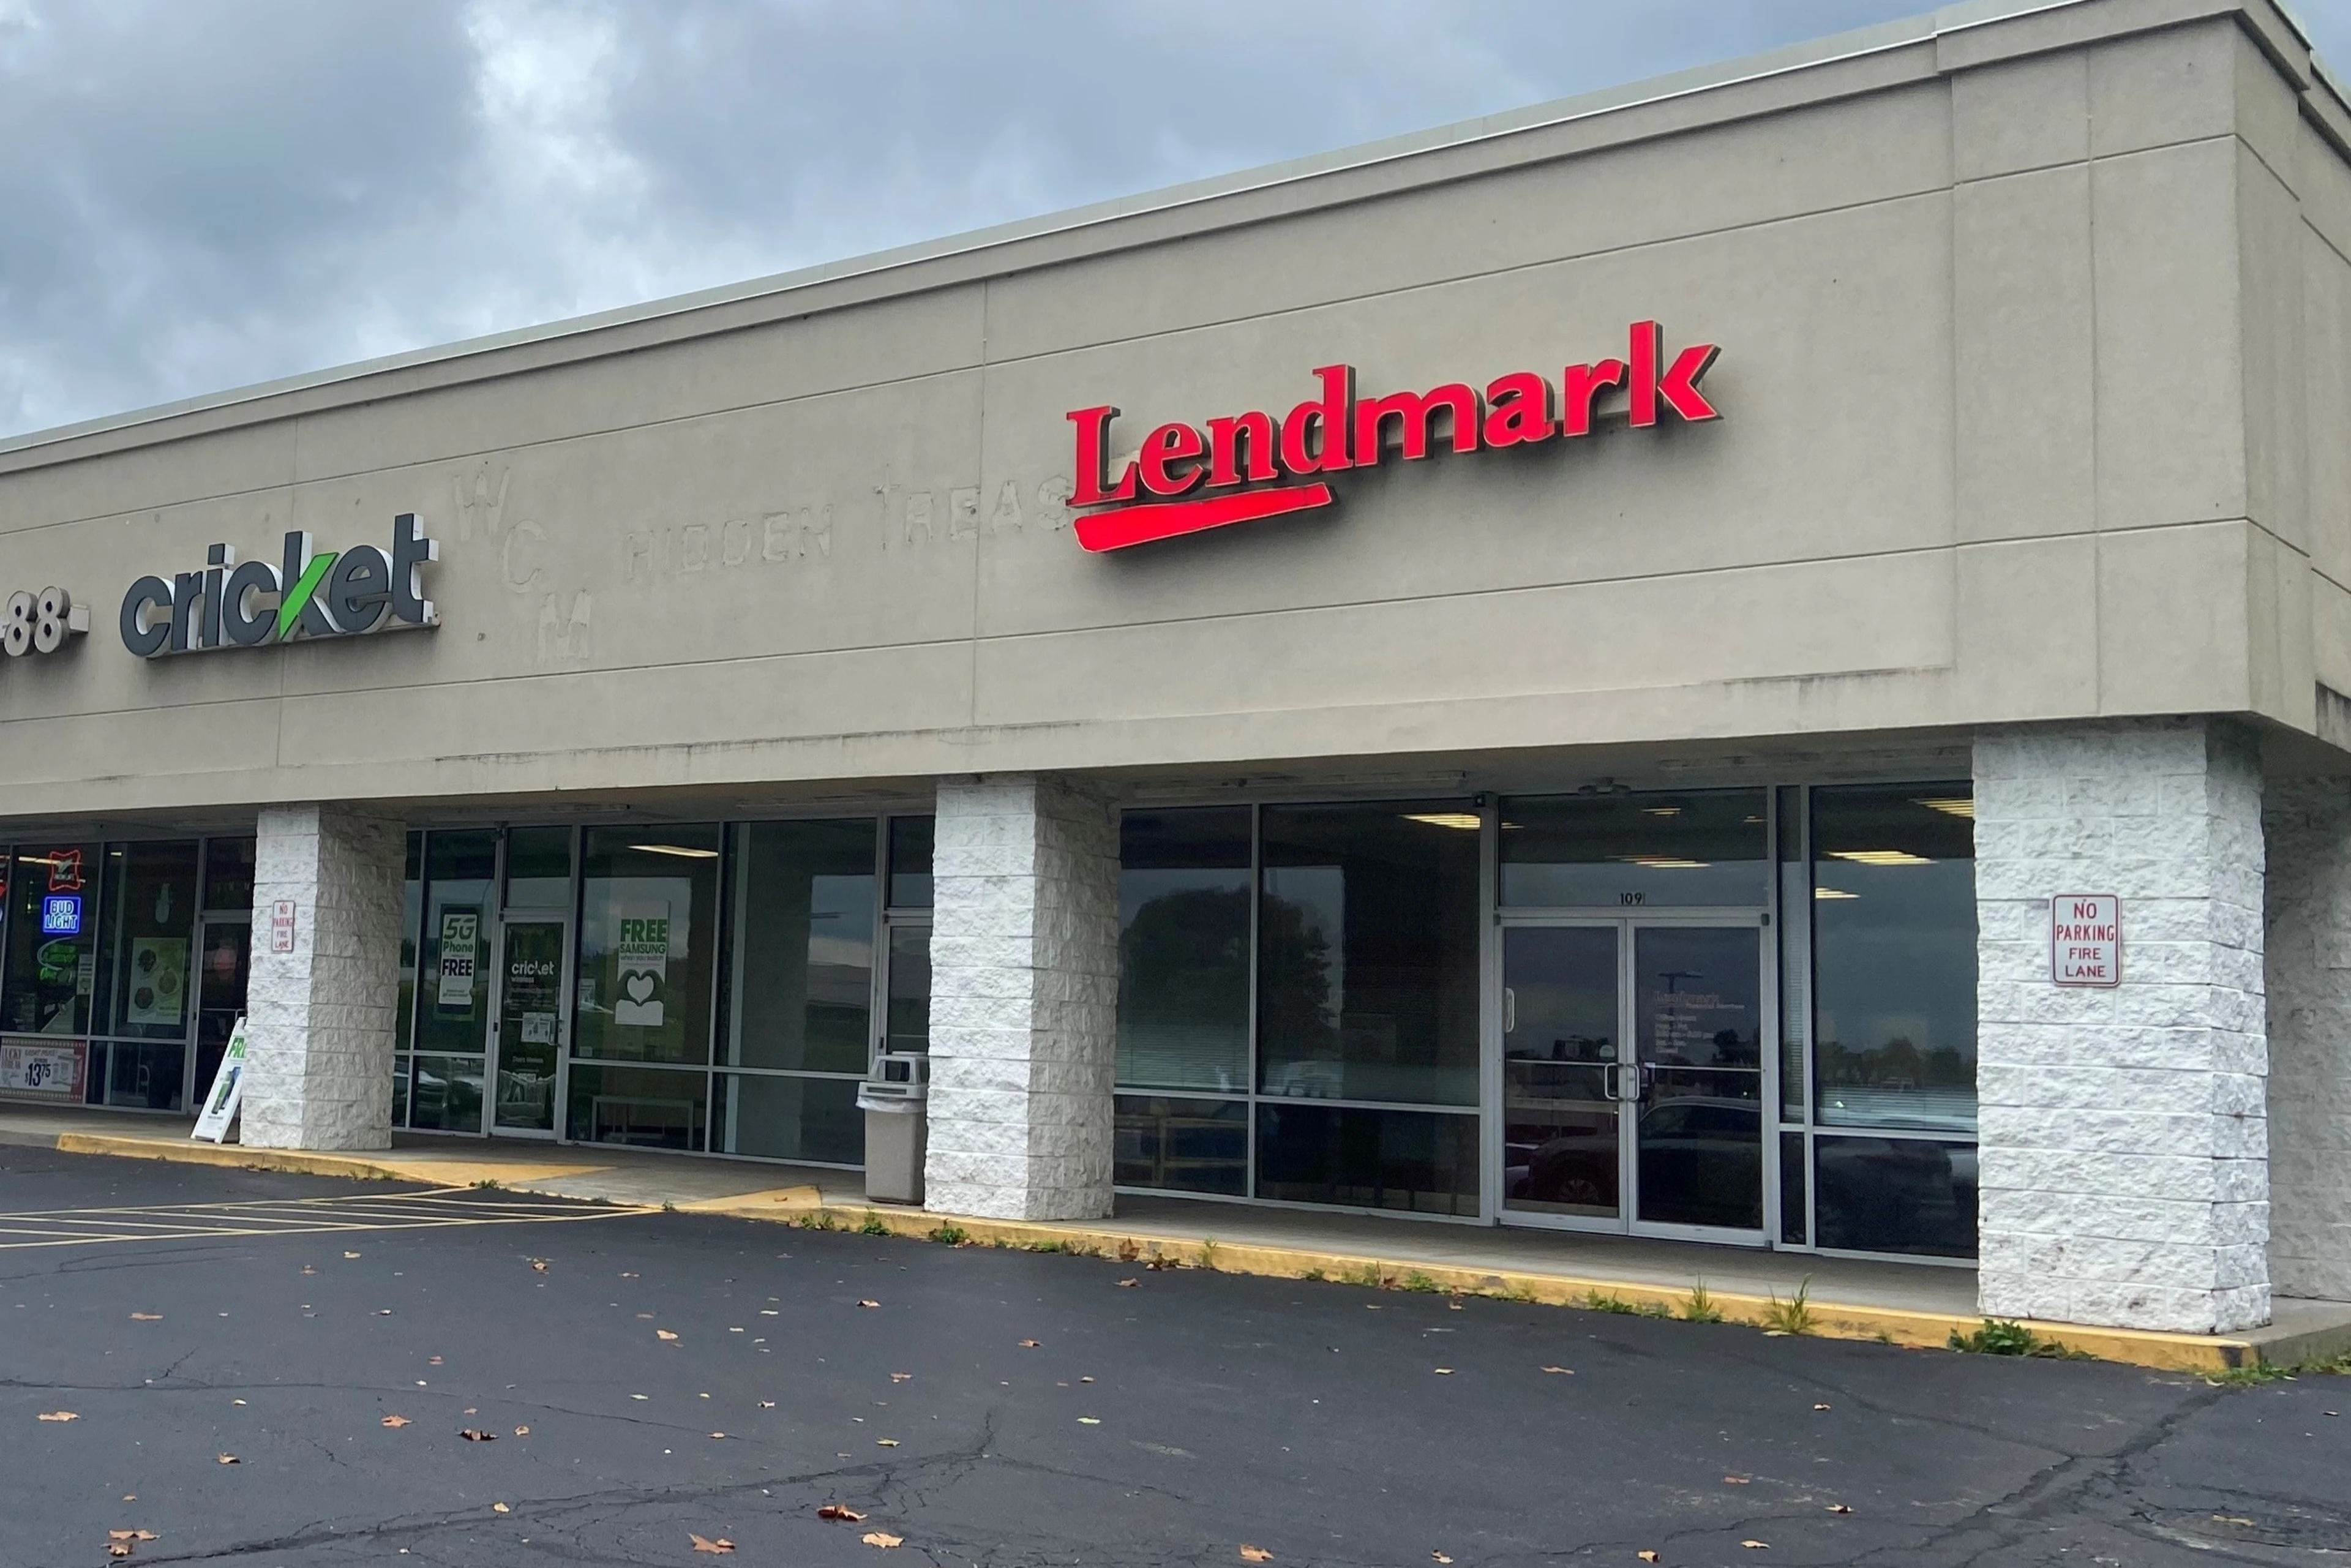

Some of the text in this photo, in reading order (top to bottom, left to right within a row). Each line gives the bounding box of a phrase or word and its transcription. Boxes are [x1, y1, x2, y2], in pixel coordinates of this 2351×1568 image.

[1065, 319, 1722, 506] Lendmark
[119, 512, 439, 658] cricket
[50, 900, 74, 913] BUD
[279, 905, 288, 915] NO
[2074, 902, 2097, 919] NO
[45, 915, 78, 929] LIGHT
[444, 918, 476, 940] 5G
[620, 919, 667, 942] FREE
[2057, 925, 2115, 941] PARKING
[443, 941, 474, 953] Phone
[620, 943, 666, 954] SAMSUNG
[2069, 948, 2102, 960] FIRE
[441, 959, 473, 976] FREE
[511, 960, 555, 975] cricket
[2065, 965, 2107, 978] LANE
